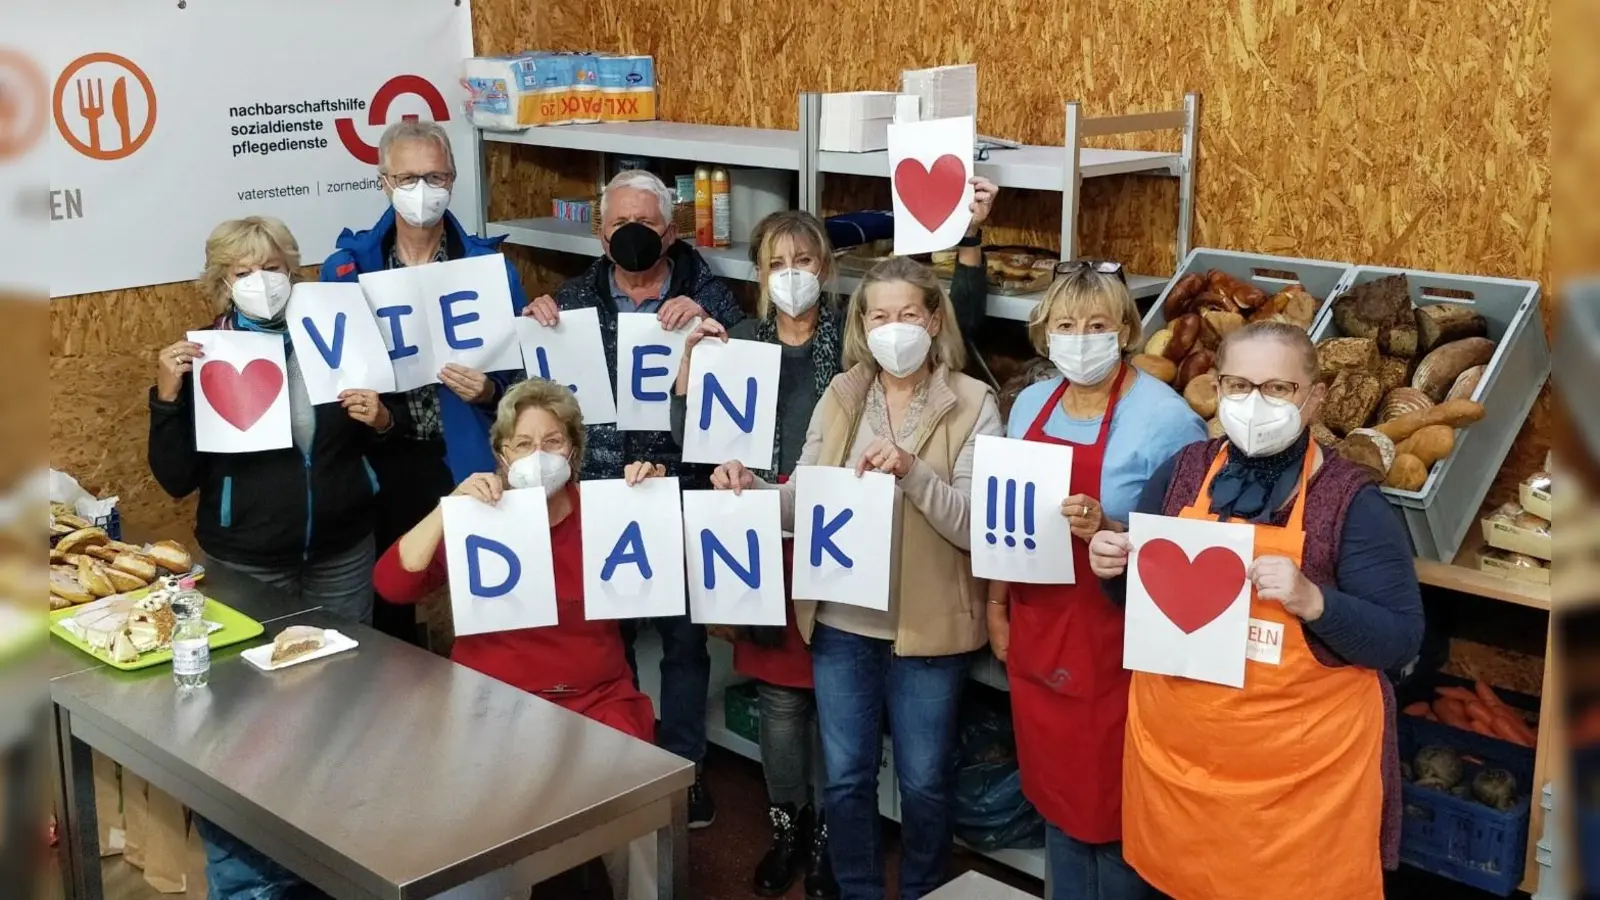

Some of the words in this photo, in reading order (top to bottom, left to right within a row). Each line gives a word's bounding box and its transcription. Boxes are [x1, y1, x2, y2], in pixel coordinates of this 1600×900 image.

[229, 98, 366, 117] nachbarschaftshilfe
[606, 98, 639, 115] XXL
[231, 119, 324, 136] sozialdienste
[232, 136, 328, 157] pflegedienste
[237, 185, 310, 200] vaterstetten
[985, 475, 1036, 550] !!!
